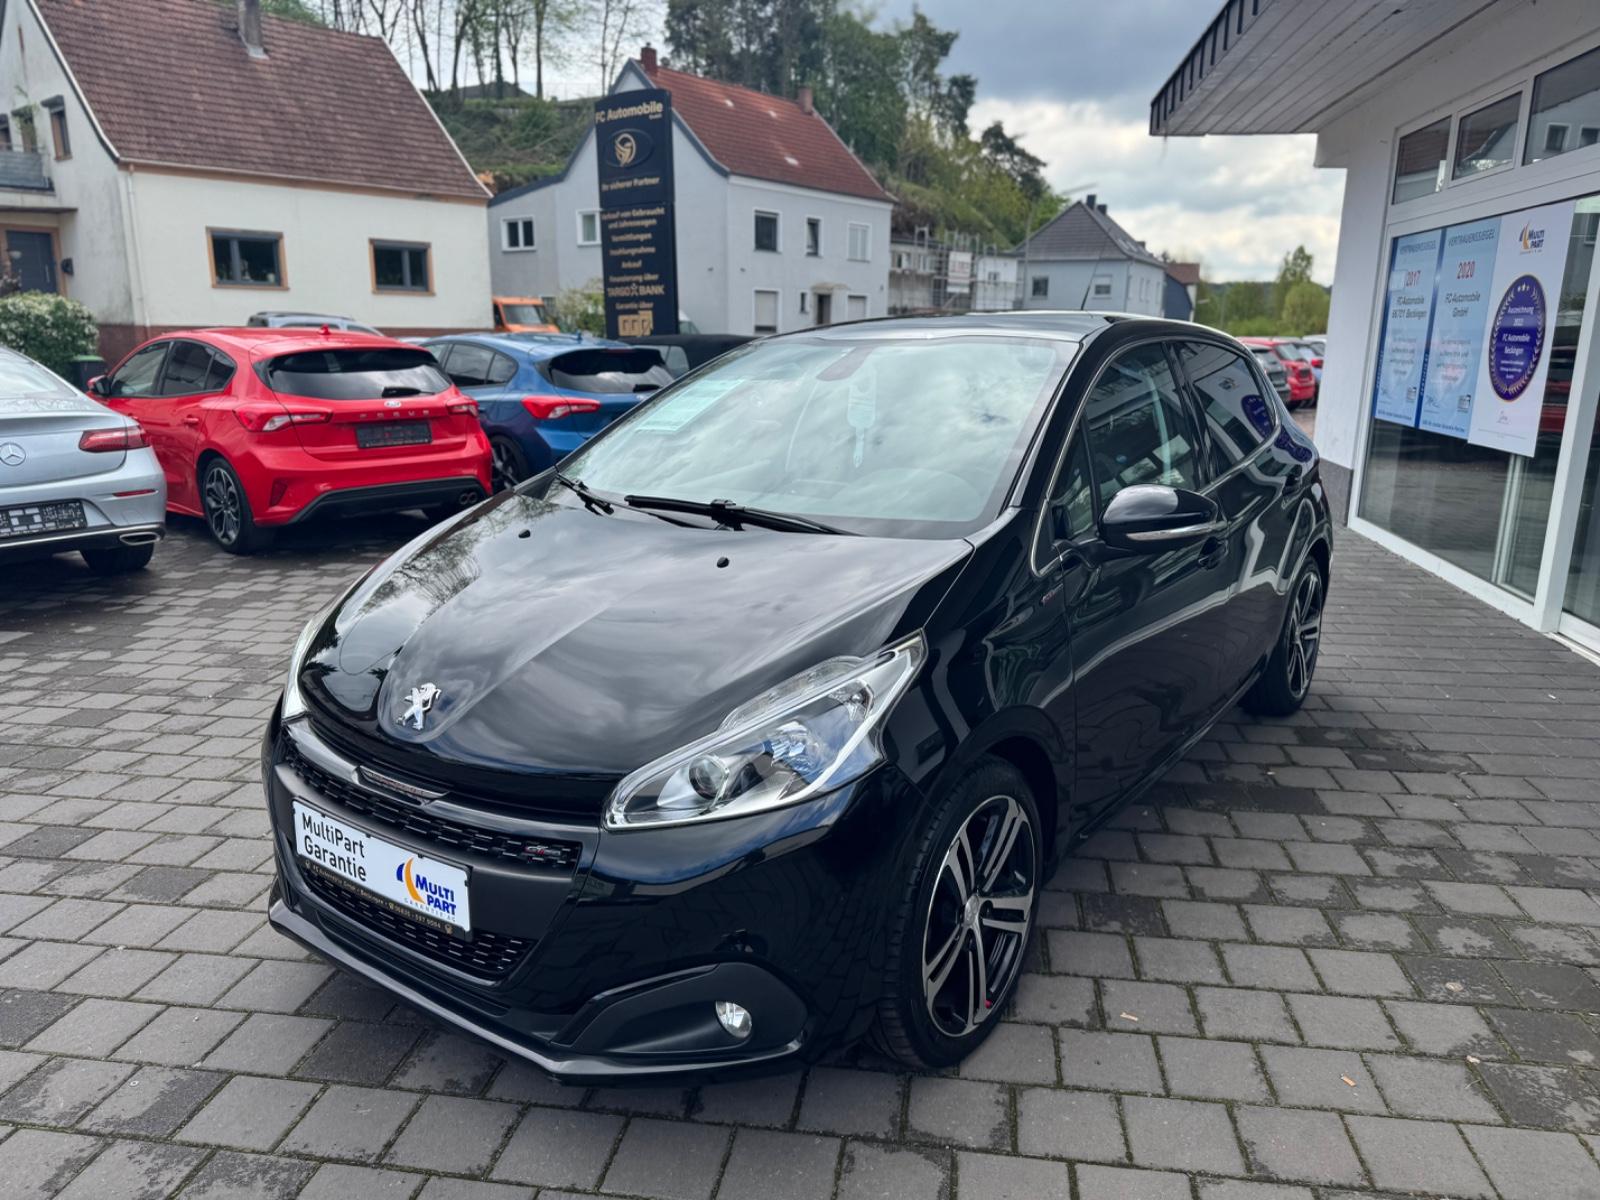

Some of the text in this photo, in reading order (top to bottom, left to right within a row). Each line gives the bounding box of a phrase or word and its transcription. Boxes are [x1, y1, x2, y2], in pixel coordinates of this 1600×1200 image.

[595, 101, 663, 124] FC Automobile
[633, 177, 660, 186] Partner
[632, 207, 665, 217] Gebraucht
[1405, 270, 1421, 287] 2017
[1457, 260, 1476, 279] 2020
[639, 285, 665, 296] BANK
[1453, 291, 1480, 302] Automobile
[1509, 333, 1530, 342] Automobile
[302, 812, 365, 858] MultiPart
[304, 835, 367, 882] Garantie
[415, 874, 455, 902] MULTI
[427, 895, 456, 916] PART
